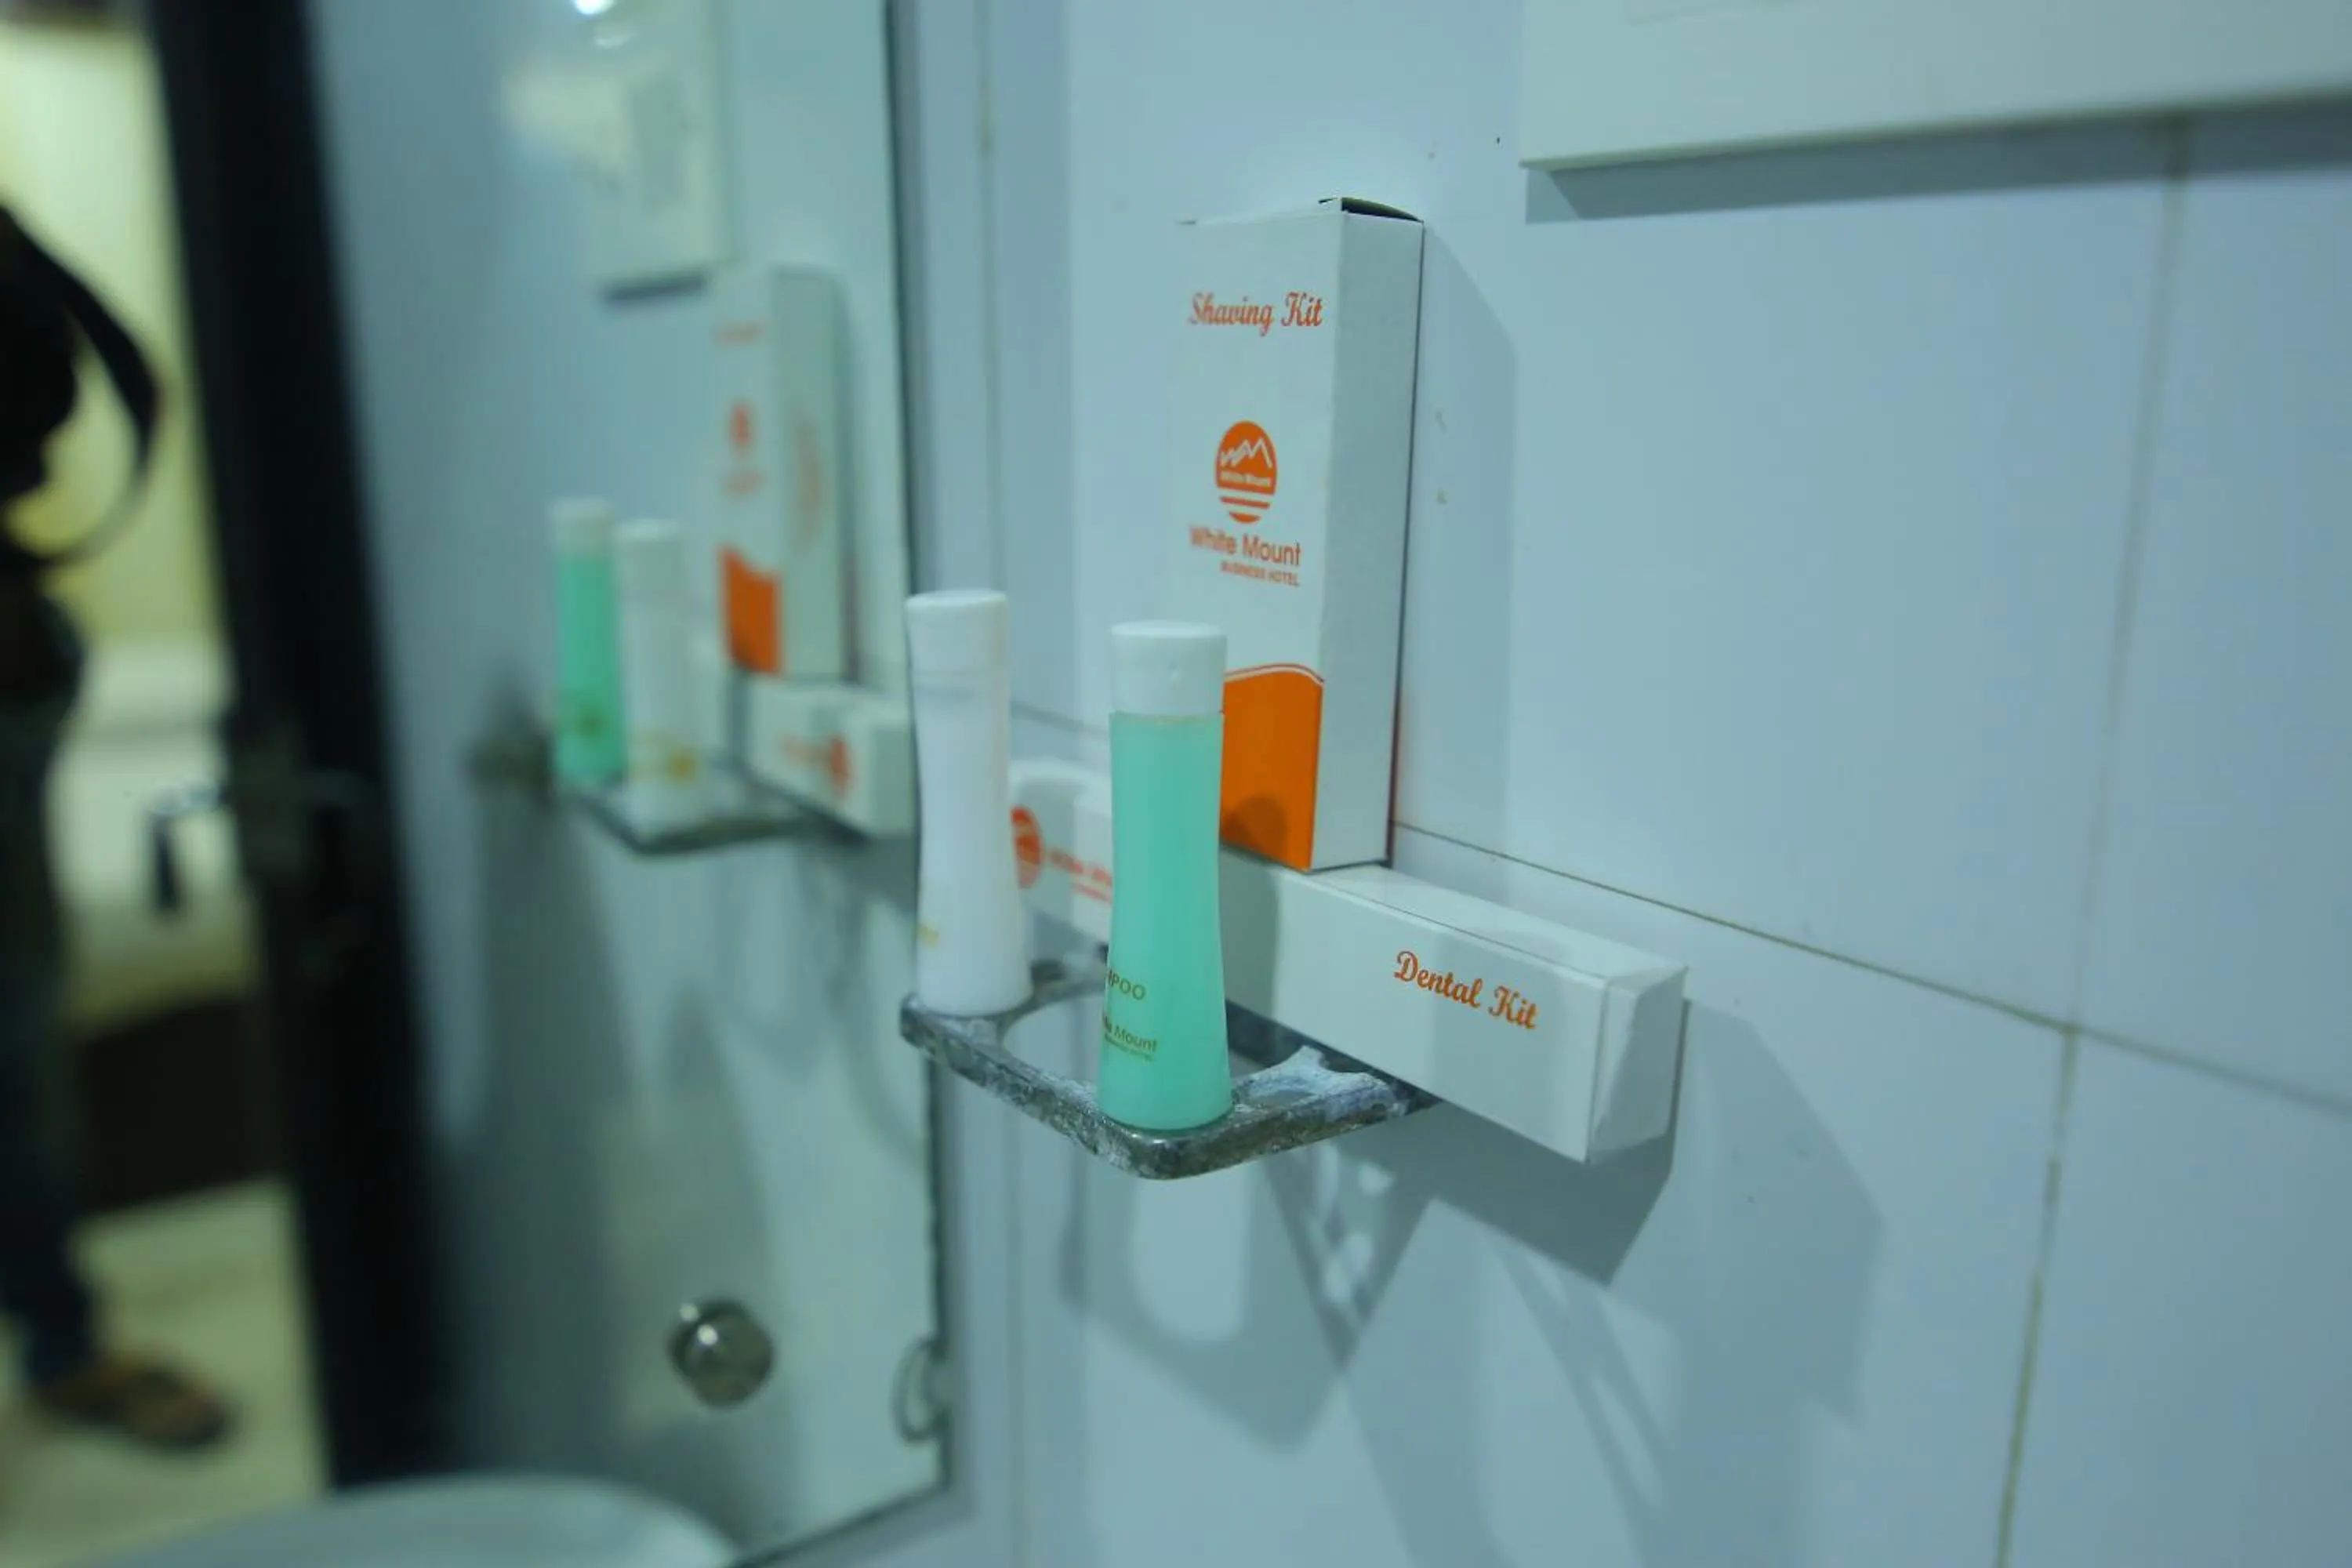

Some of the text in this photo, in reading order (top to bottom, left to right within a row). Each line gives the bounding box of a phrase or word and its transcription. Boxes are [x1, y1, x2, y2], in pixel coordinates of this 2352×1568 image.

[1188, 291, 1323, 337] Shaving Kit
[1190, 525, 1301, 566] White Mount
[1107, 968, 1146, 1000] POO
[1394, 950, 1538, 1029] Dental Kit
[1113, 1025, 1158, 1053] Mount
